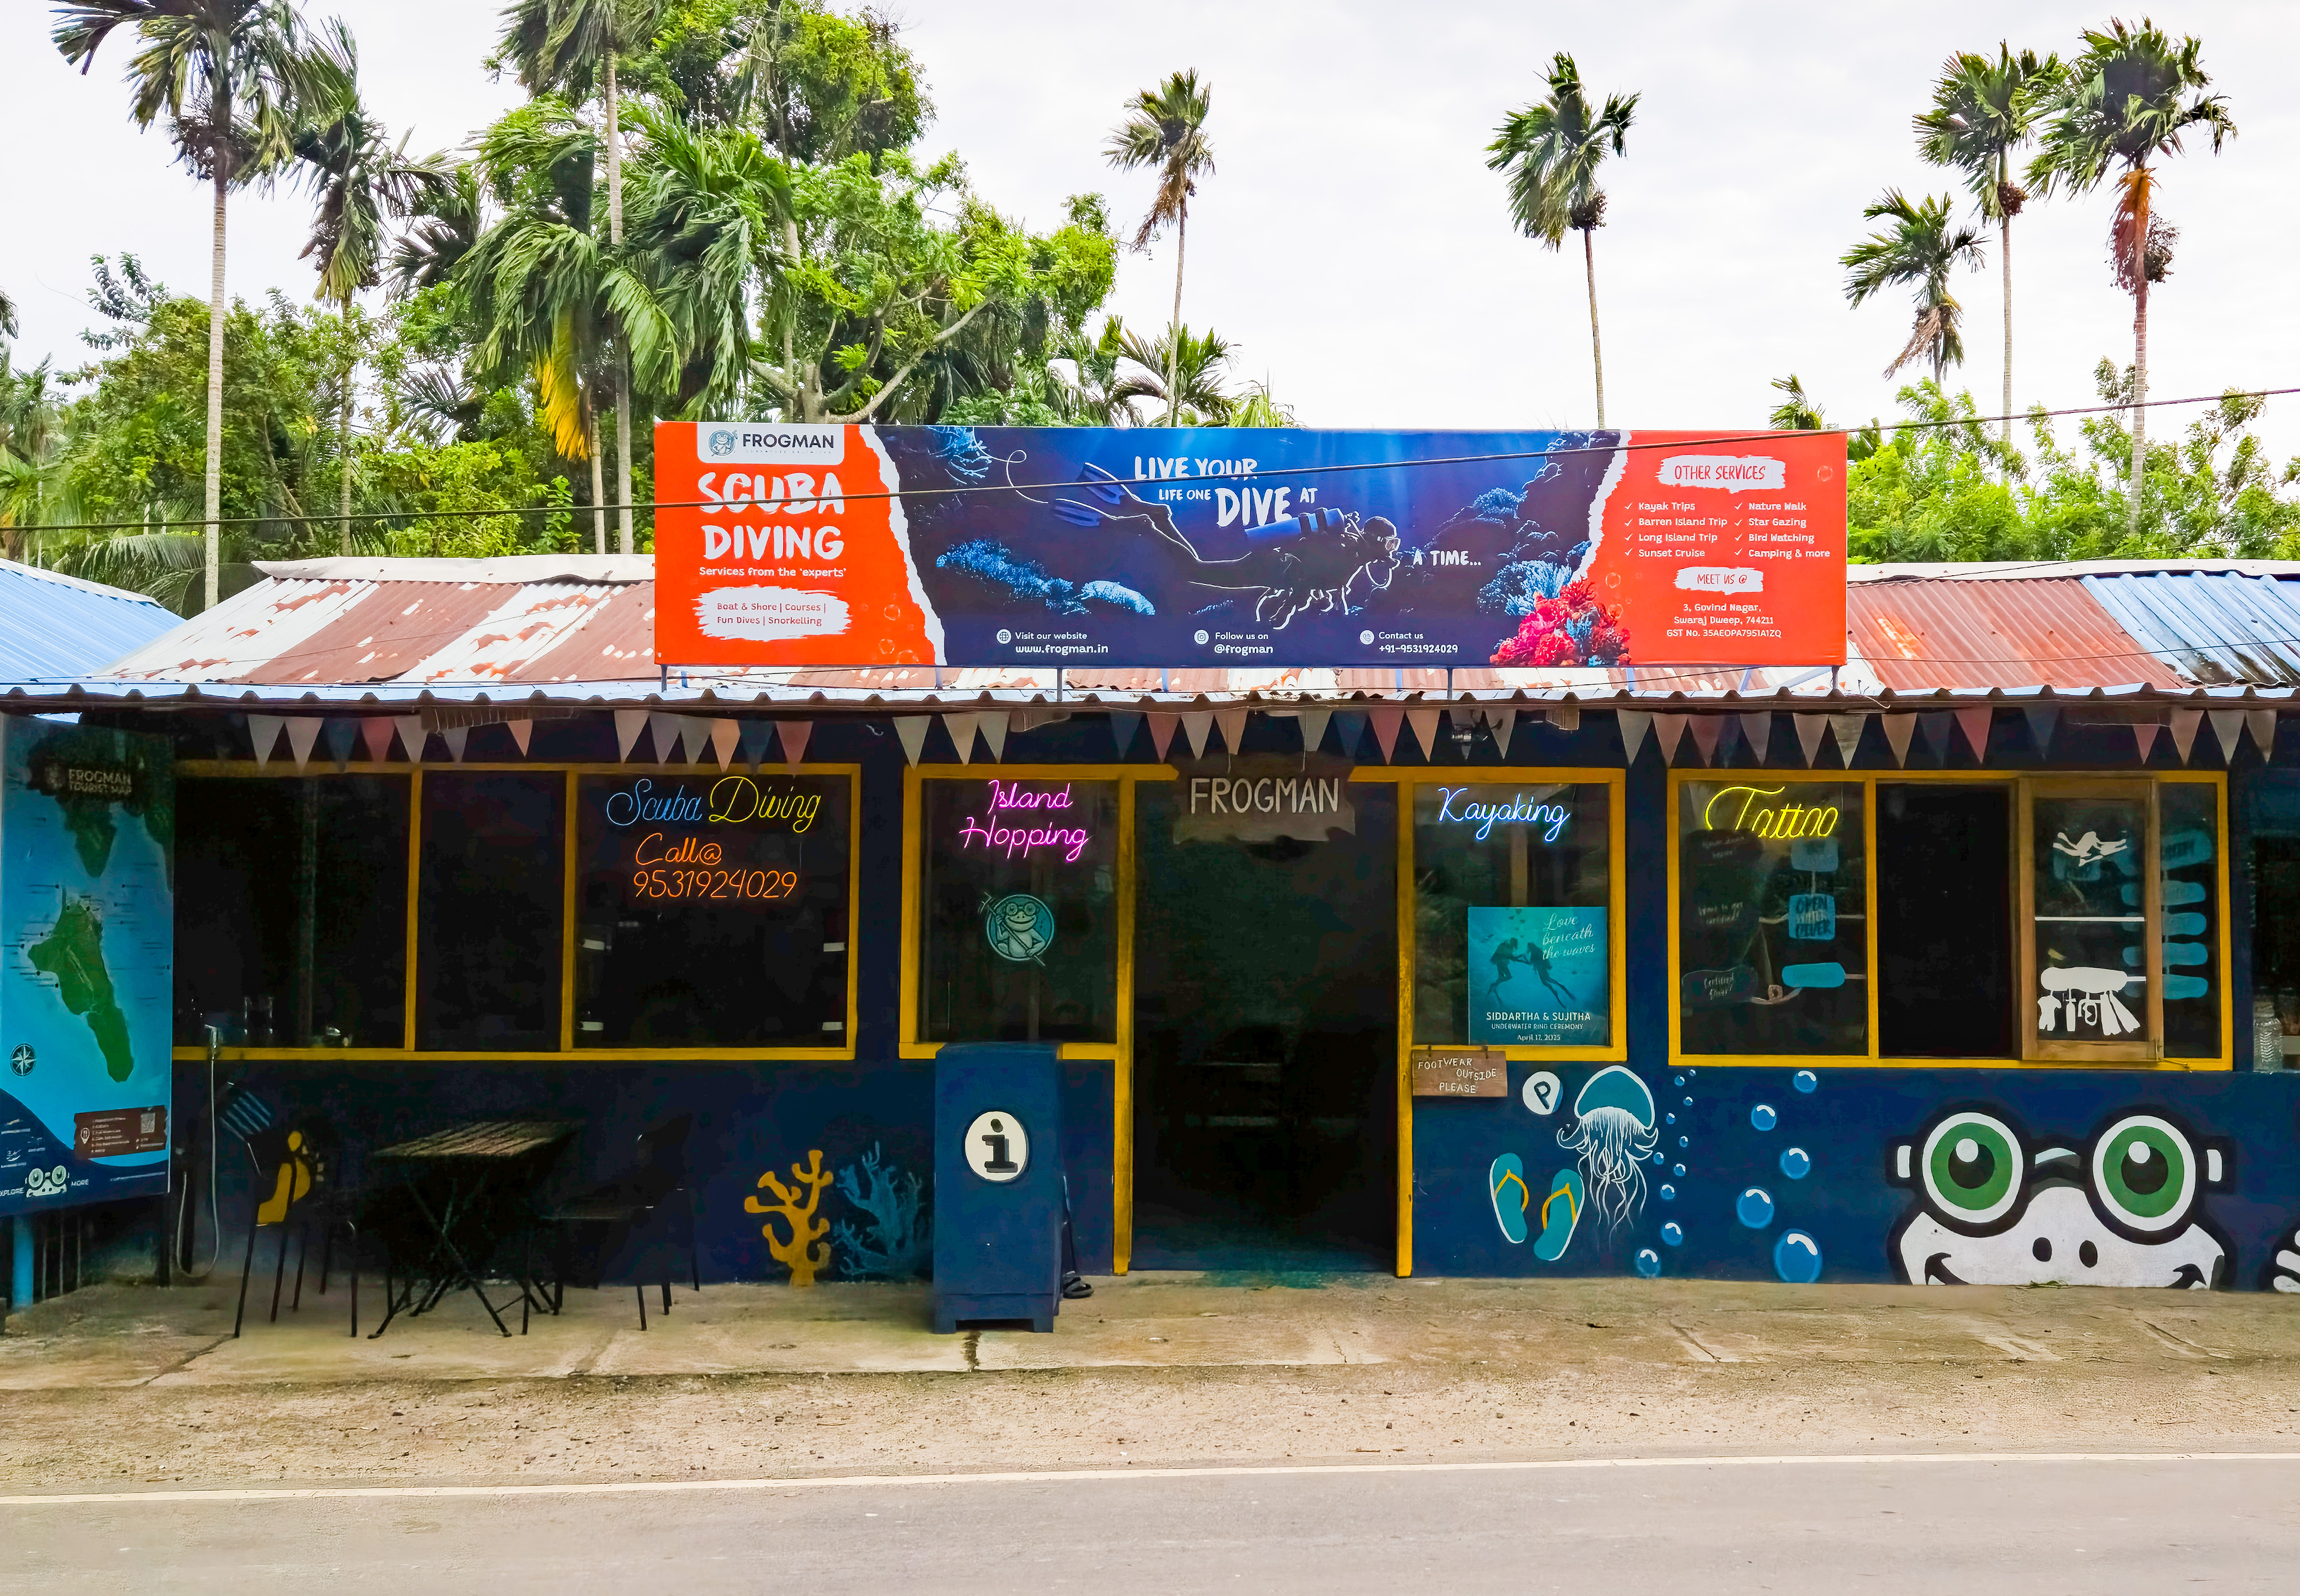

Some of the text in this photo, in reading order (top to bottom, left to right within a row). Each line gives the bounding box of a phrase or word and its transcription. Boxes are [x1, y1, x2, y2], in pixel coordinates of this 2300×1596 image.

[743, 434, 834, 448] FROGMAN
[1134, 456, 1259, 480] LIVE YOUR
[1675, 464, 1766, 480] OTHER SERVICES
[697, 472, 845, 515] SCUBA
[1159, 487, 1318, 527] LIFE ONE DIVE AT
[1639, 502, 1695, 512] Kayak Trips
[1749, 502, 1807, 510] Nature Walk
[1639, 517, 1727, 527] Barren Island Trip
[1749, 517, 1807, 528] Star Gazing
[701, 525, 845, 560] DIVING
[1639, 533, 1718, 544] Long Island Trip
[1749, 533, 1814, 544] Bird Watching
[1413, 549, 1481, 566] A TIME...
[1638, 549, 1705, 557] Sunset Cruise
[1748, 549, 1792, 559] Camping
[1795, 549, 1802, 557] &
[699, 567, 745, 576] Services
[748, 567, 775, 576] from
[778, 567, 796, 576] the
[1697, 574, 1748, 585] MEET US @
[1683, 604, 1692, 612] 3,
[1694, 603, 1727, 611] Govind
[768, 617, 822, 626] Snorkelling
[1674, 616, 1774, 626] Swaraj Dweep, 744211
[1015, 644, 1108, 655] www.frogman.in
[1214, 643, 1273, 656] @frogman
[1379, 644, 1458, 653] +91-9531924029
[68, 769, 132, 786] FROGMAN
[988, 779, 1074, 815] Island
[1191, 777, 1339, 814] FROGMAN
[606, 776, 821, 833] Scuba Diving
[1438, 786, 1571, 842] Kayaking
[1704, 786, 1839, 839] Tattoo
[959, 815, 1090, 862] Hopping
[635, 832, 722, 866] Call@
[633, 869, 797, 899] 9531924029
[1543, 913, 1579, 932] Love
[1543, 924, 1594, 945] beneath
[1543, 944, 1595, 960] the waves
[1486, 1012, 1591, 1021] SIDDARTHA & SUJITHA
[1418, 1057, 1472, 1070] FOOTWEAR
[1456, 1068, 1497, 1080] OUTSIDE
[1439, 1082, 1477, 1094] PLEASE
[0, 1187, 24, 1197] XPLORE
